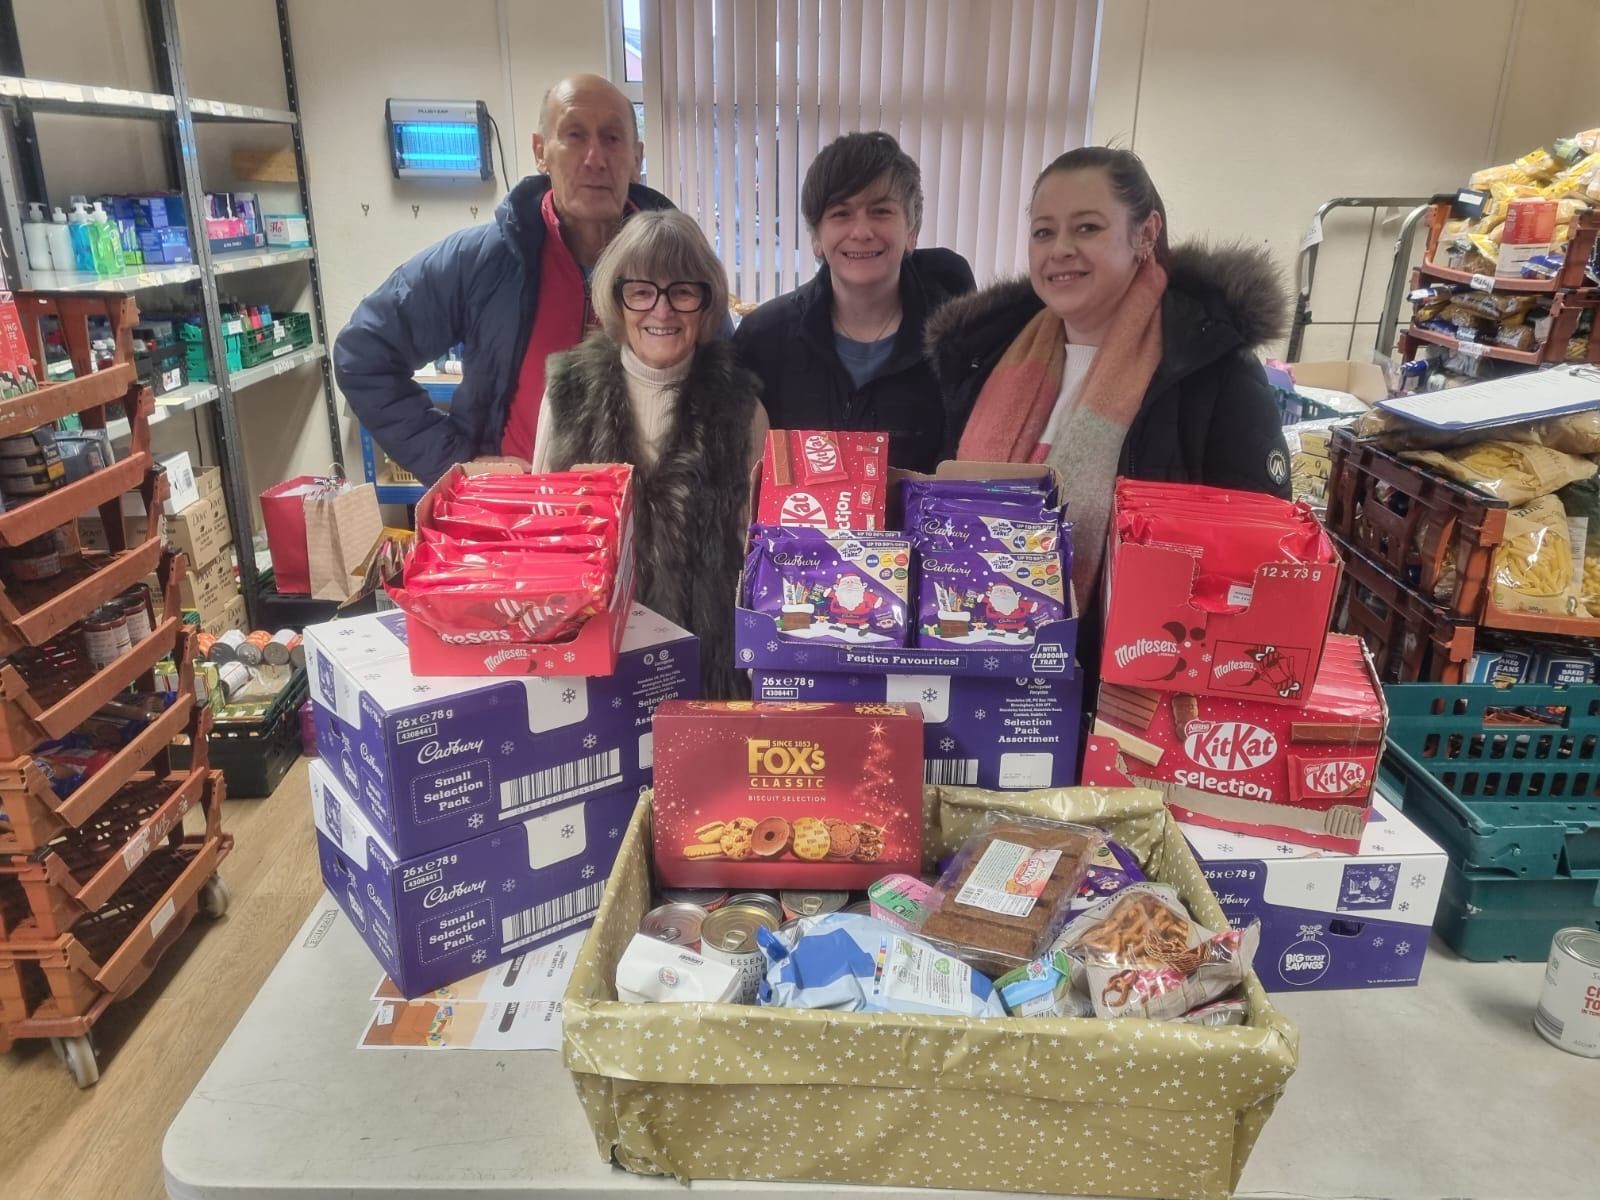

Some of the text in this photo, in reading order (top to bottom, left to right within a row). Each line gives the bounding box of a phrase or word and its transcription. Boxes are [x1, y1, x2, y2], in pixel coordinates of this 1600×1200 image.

[834, 491, 852, 530] ction
[924, 519, 970, 542] Cadbury
[774, 553, 820, 570] Cadbury
[922, 558, 972, 577] Cadbury
[1262, 567, 1321, 581] 12 x 73 g
[484, 648, 528, 672] Maltesers
[847, 654, 959, 666] Festive Favourites!
[1115, 638, 1177, 668] Maltesers
[1214, 660, 1254, 679] Maltesers
[762, 678, 774, 686] 26
[794, 678, 806, 686] 78
[808, 679, 814, 688] g
[1558, 675, 1584, 683] BEANS
[638, 691, 678, 708] Selection
[396, 719, 410, 729] 26
[411, 718, 418, 726] x
[431, 710, 445, 720] 78
[446, 709, 453, 719] g
[1004, 718, 1052, 726] Selection
[402, 727, 432, 740] 4308441
[417, 739, 483, 764] Cadbury
[1193, 724, 1274, 770] KitKat
[434, 770, 471, 788] Small
[750, 778, 824, 787] CLASSIC
[1174, 770, 1272, 800] Selection
[1313, 763, 1362, 792] KitKat
[424, 781, 483, 803] Selection
[439, 796, 471, 811] Pack
[403, 867, 416, 878] 26
[417, 866, 423, 874] x
[436, 856, 449, 867] 78
[450, 855, 457, 864] g
[1204, 870, 1215, 879] 26
[1235, 870, 1247, 878] 78
[1249, 871, 1256, 880] g
[423, 880, 486, 908] Cadbury
[1213, 890, 1250, 907] dbury
[440, 910, 474, 929] Small
[429, 918, 486, 944] Selection
[444, 934, 474, 950] Pack
[1285, 962, 1324, 971] SAVINGS
[1286, 954, 1304, 962] BIG
